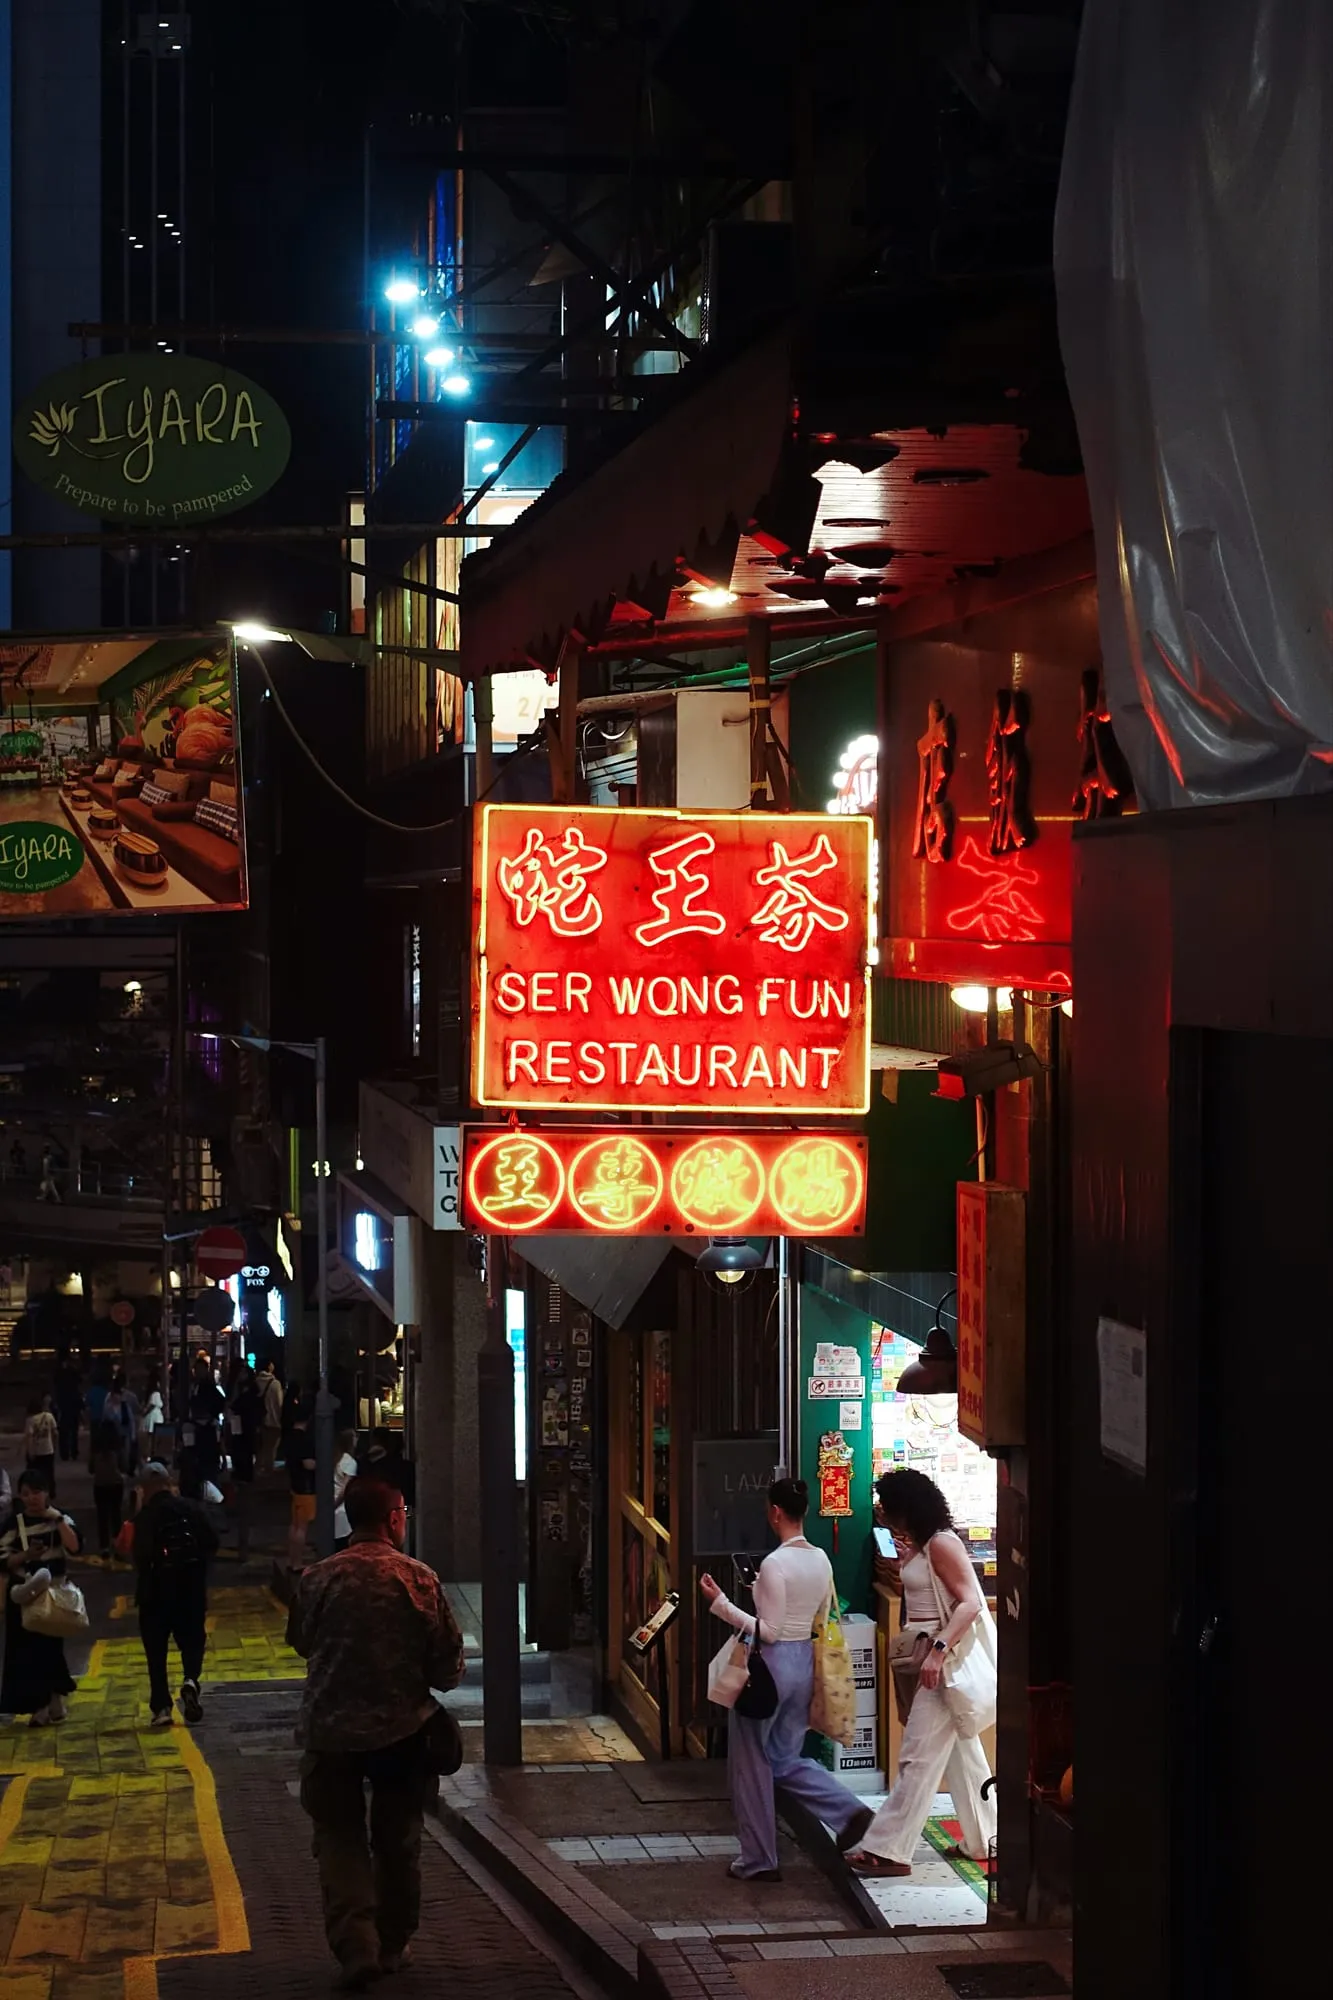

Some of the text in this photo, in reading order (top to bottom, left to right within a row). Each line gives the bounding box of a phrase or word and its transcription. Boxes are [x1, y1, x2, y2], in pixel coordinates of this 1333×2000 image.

[55, 473, 254, 520] Prepare to be pampered
[500, 827, 849, 952] 蛇王芬
[497, 971, 593, 1014] SER
[759, 978, 851, 1019] FUN
[507, 1041, 841, 1089] RESTAURANT
